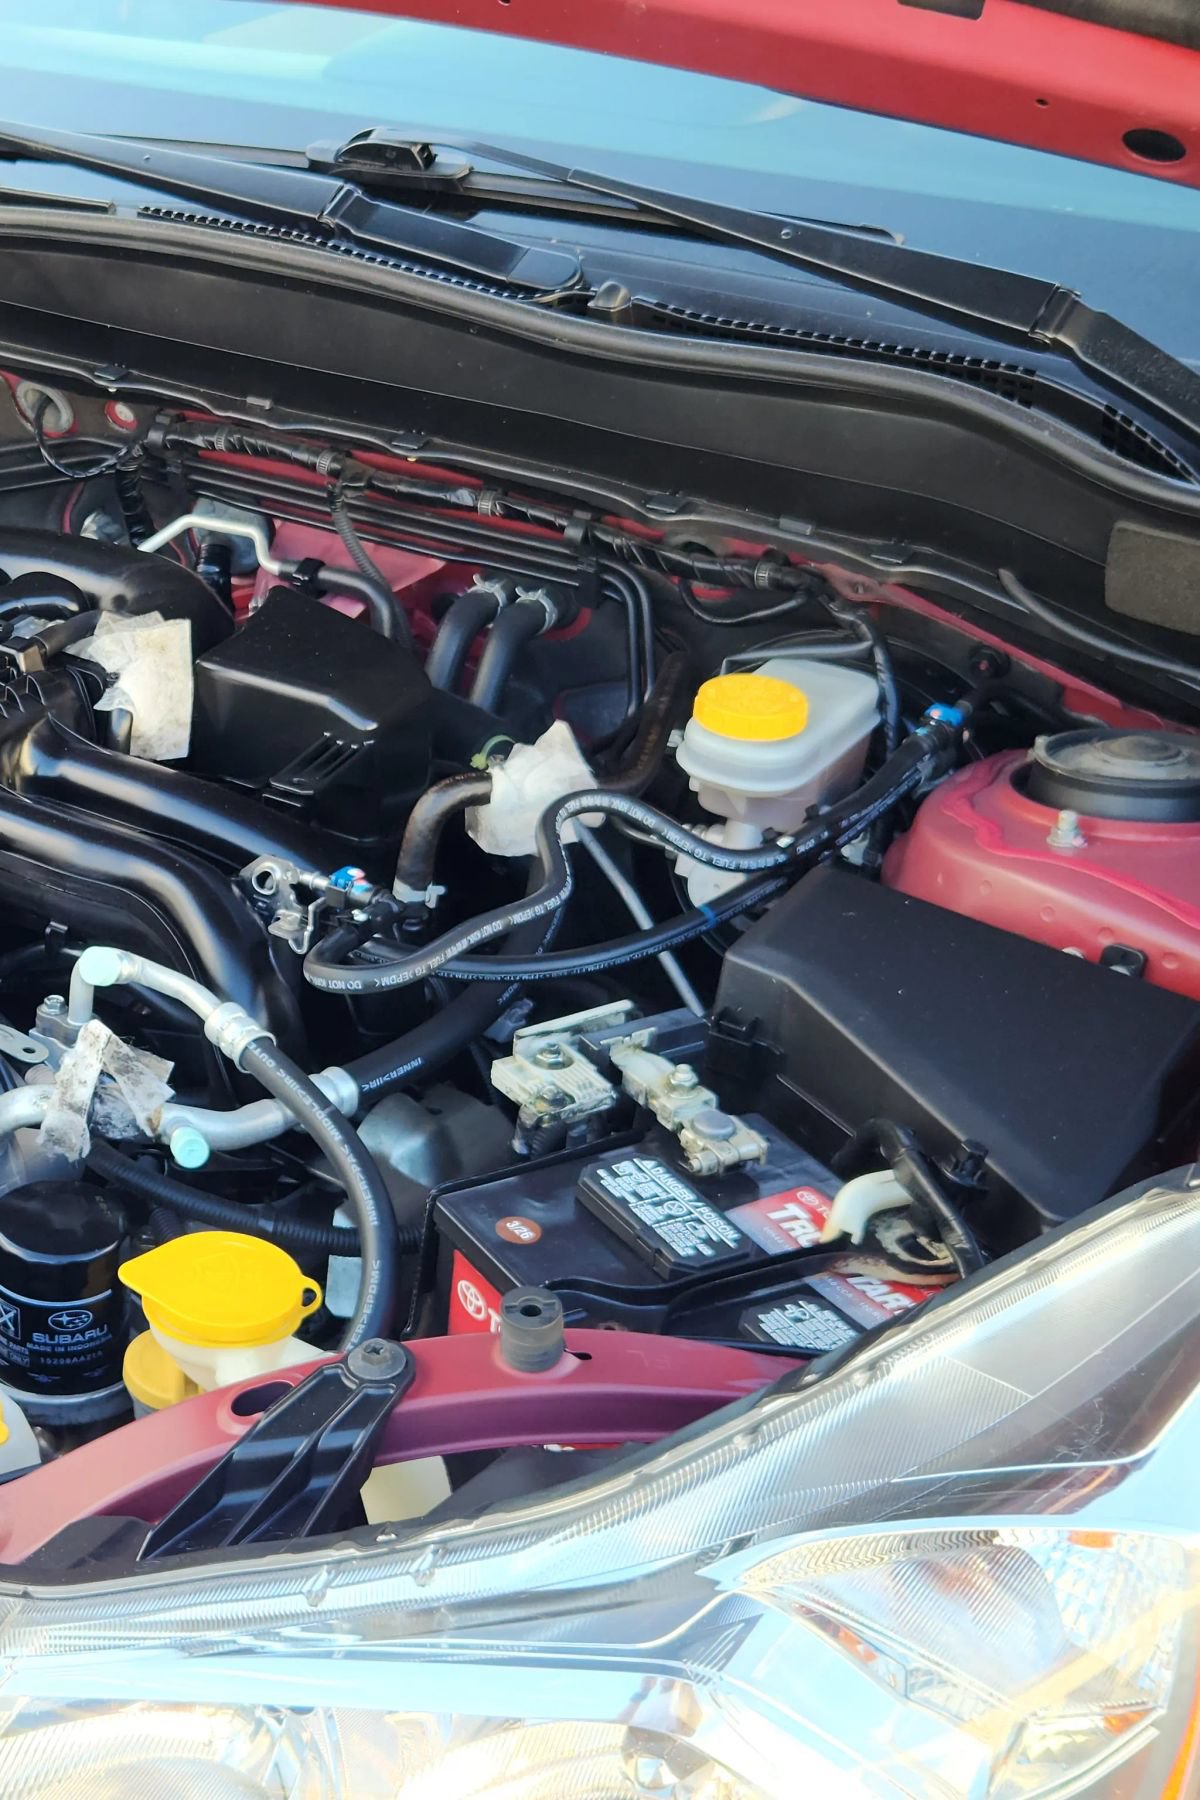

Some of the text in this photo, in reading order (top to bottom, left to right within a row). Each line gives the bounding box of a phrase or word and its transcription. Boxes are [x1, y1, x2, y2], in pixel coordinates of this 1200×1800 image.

[346, 979, 362, 990] DO
[246, 1041, 276, 1067] OUTE
[505, 1220, 535, 1242] 3/26
[31, 1324, 108, 1344] SUBARU
[26, 1342, 52, 1352] MADE
